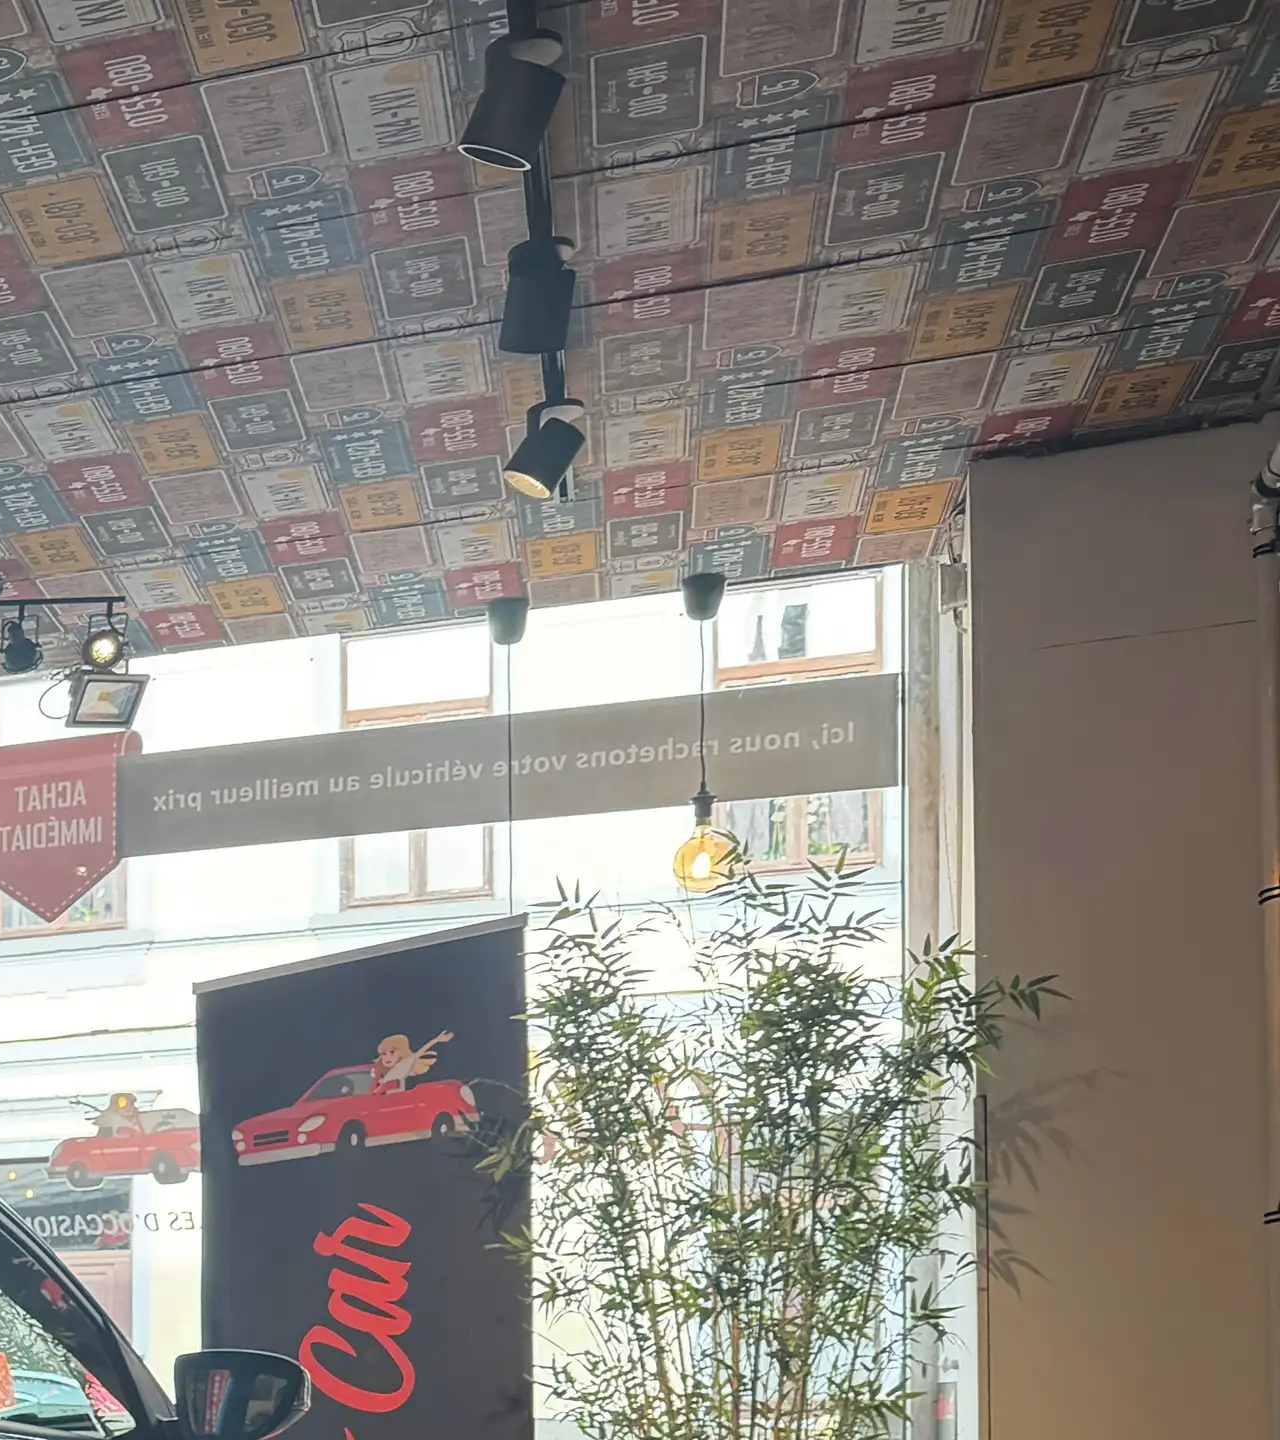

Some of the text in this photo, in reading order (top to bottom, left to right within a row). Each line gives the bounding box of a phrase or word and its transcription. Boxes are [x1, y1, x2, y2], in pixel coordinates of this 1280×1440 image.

[762, 77, 801, 95] 15
[271, 172, 308, 188] 15
[273, 212, 336, 270] GEH-142A
[298, 1202, 417, 1413] Car
